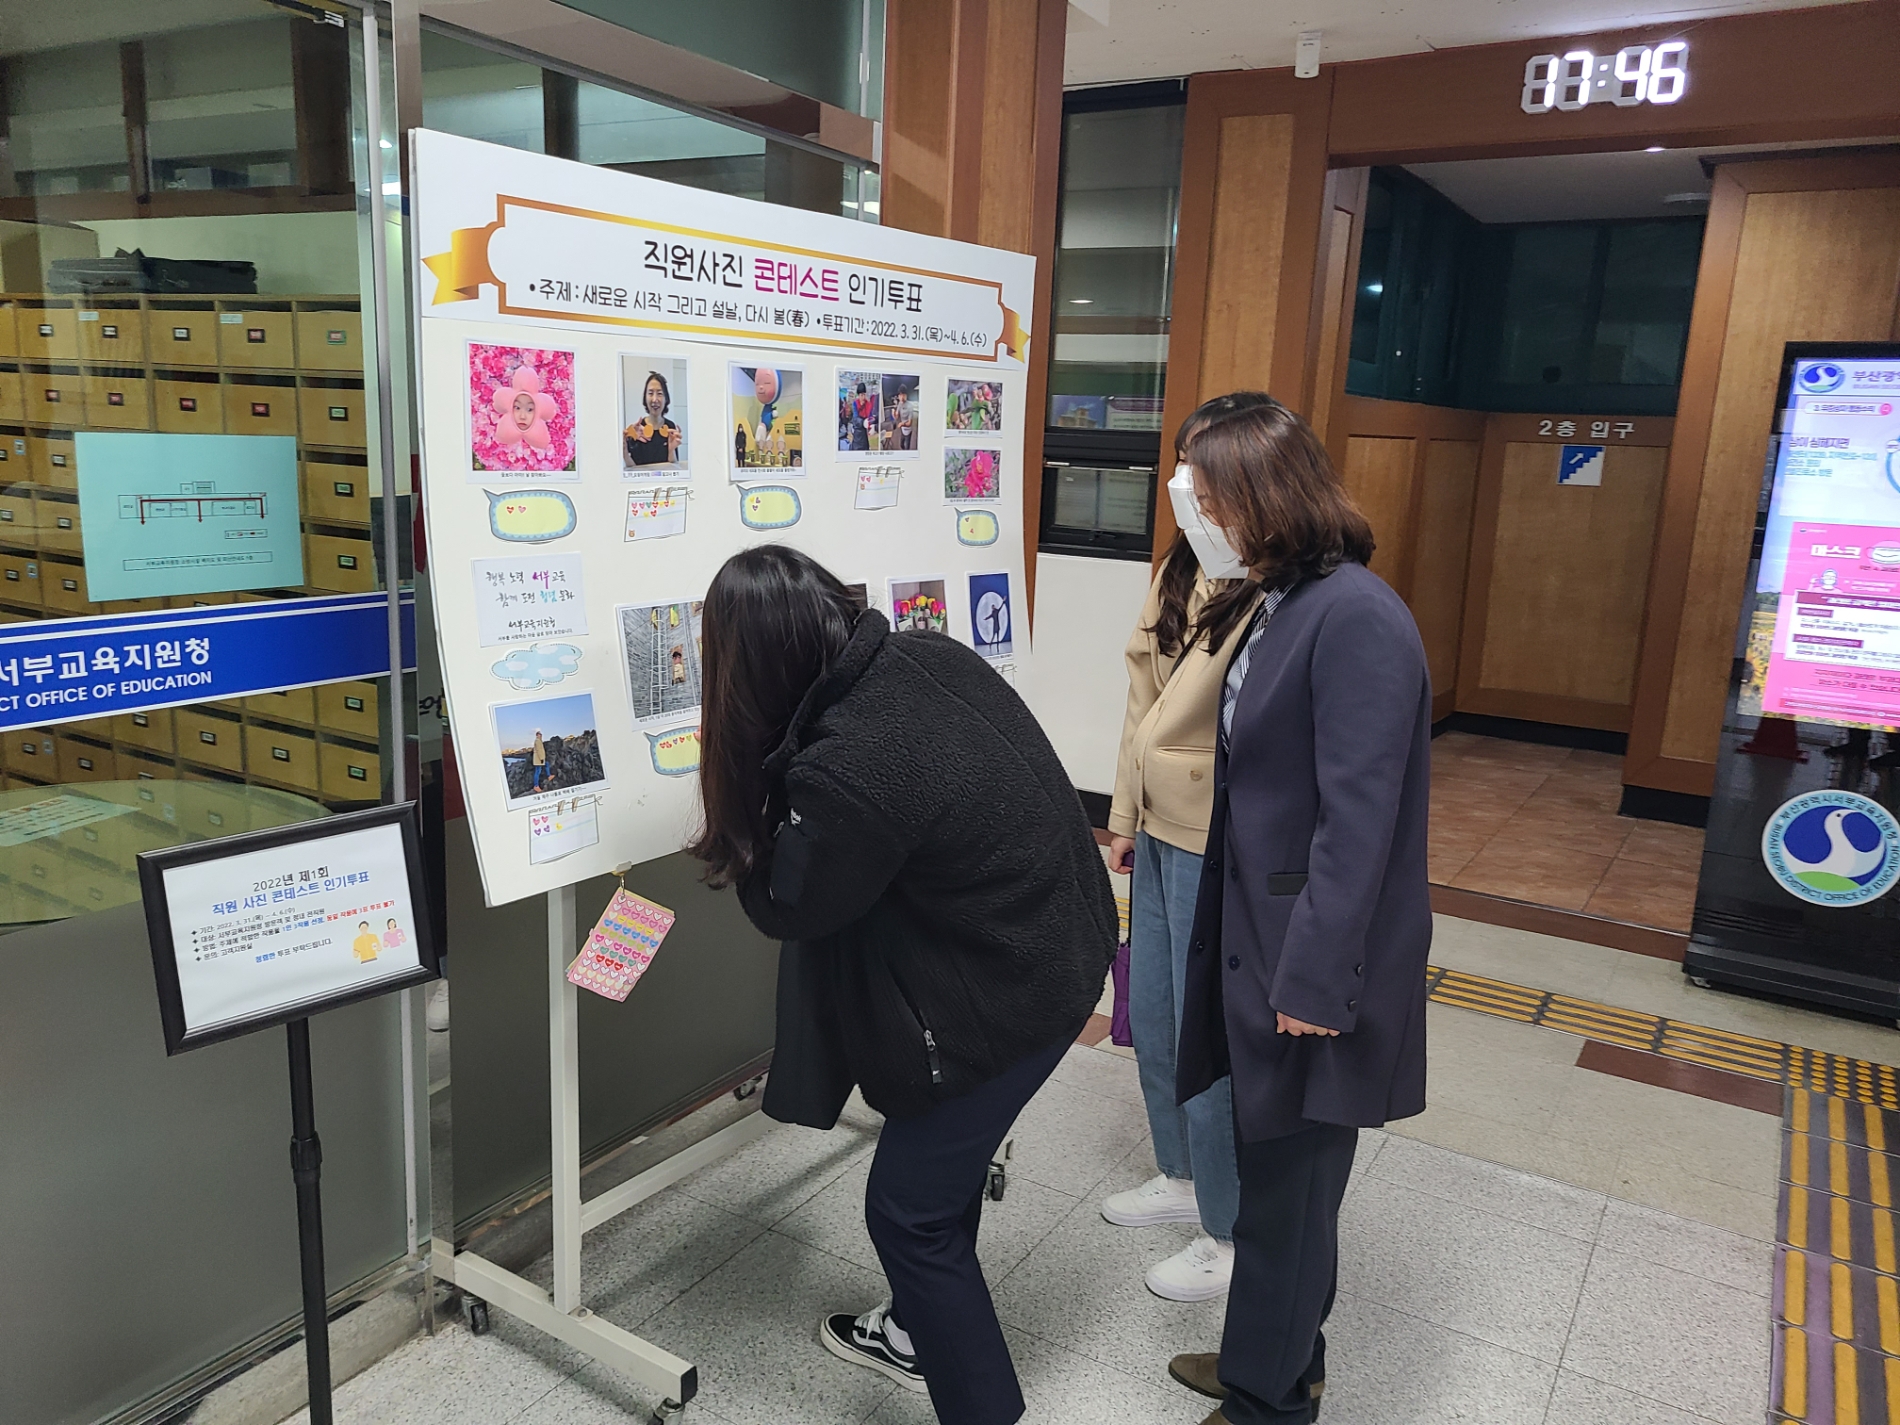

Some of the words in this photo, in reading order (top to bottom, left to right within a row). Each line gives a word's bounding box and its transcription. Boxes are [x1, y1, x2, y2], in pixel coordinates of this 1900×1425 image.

[1542, 41, 1688, 108] 17:46
[644, 240, 743, 288] 직원사진
[754, 257, 840, 302] 콘테스트
[848, 273, 923, 313] 인기투표
[582, 283, 628, 308] 새로운
[633, 290, 662, 312] 시작
[666, 294, 707, 316] 그리고
[712, 299, 742, 323] 설날,
[745, 304, 768, 324] 다시
[773, 307, 810, 328] 봄(春)
[1538, 419, 1578, 437] 2층
[1589, 421, 1636, 439] 입구
[1811, 544, 1862, 560] 마스크
[509, 571, 524, 584] 노력
[0, 638, 210, 686] 서부교육지원청
[25, 687, 88, 708] OFFICE
[92, 683, 116, 699] OF
[121, 671, 212, 695] EDUCATION
[212, 900, 238, 916] 직원
[242, 893, 268, 909] 사진
[271, 882, 321, 903] 콘테스트
[323, 871, 371, 892] 인기투표
[252, 873, 294, 892] 2022년
[299, 866, 330, 883] 제1회
[1824, 892, 1860, 901] OFFICE
[1860, 886, 1874, 897] OF
